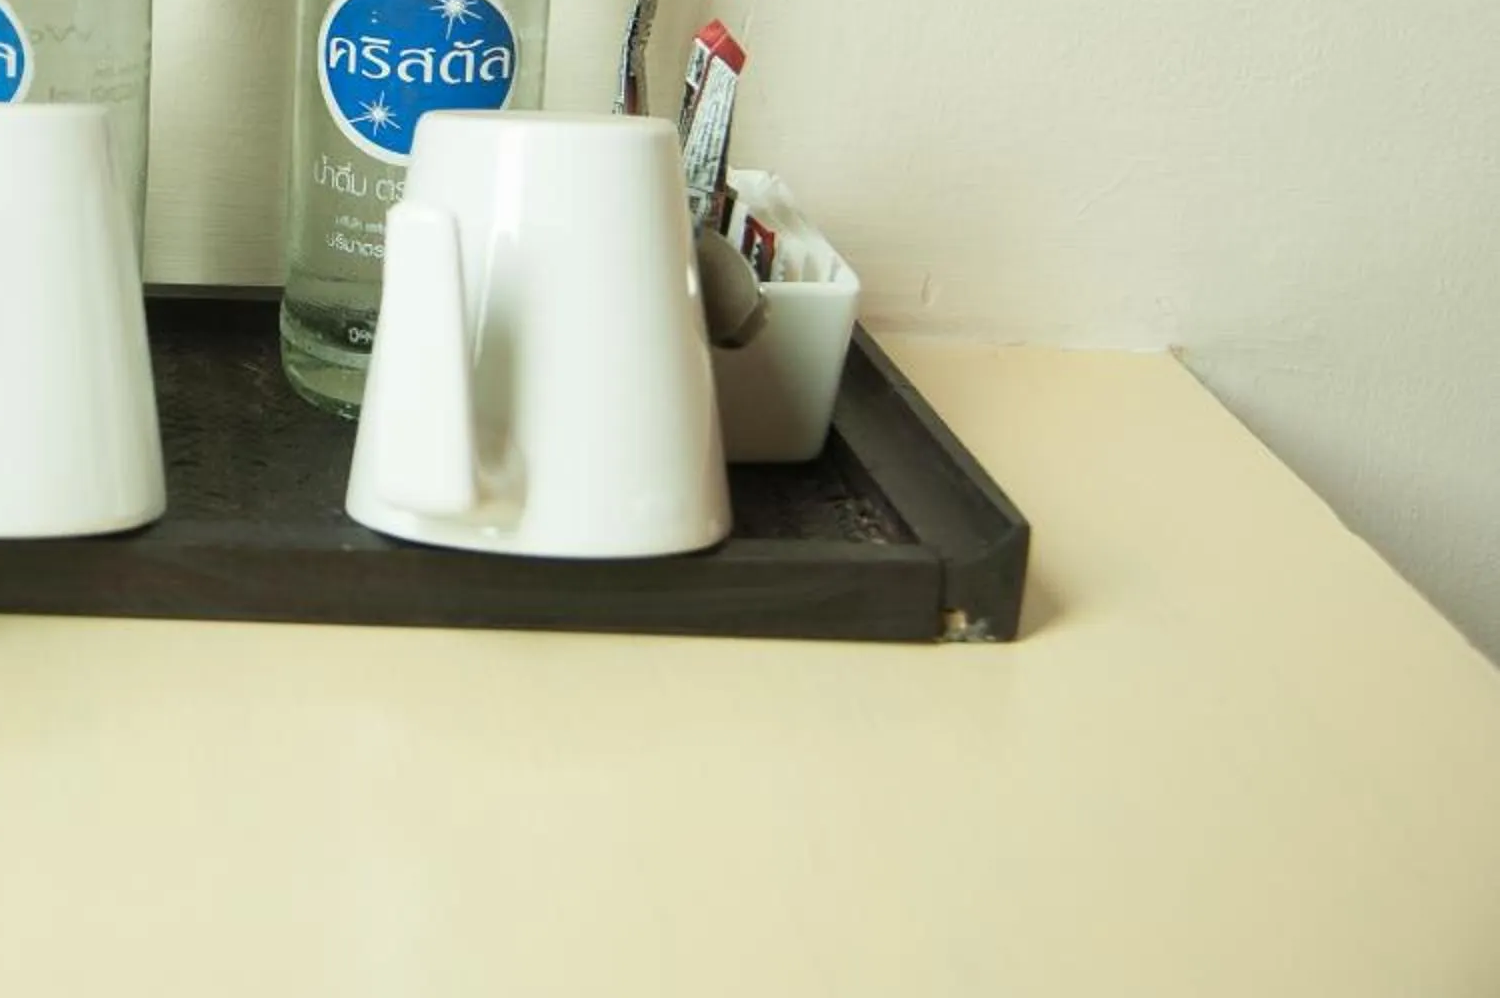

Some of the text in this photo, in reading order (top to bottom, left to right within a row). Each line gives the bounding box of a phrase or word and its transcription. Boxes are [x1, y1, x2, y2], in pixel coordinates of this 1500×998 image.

[328, 35, 511, 85] คริสตัล
[374, 178, 405, 201] ตร
